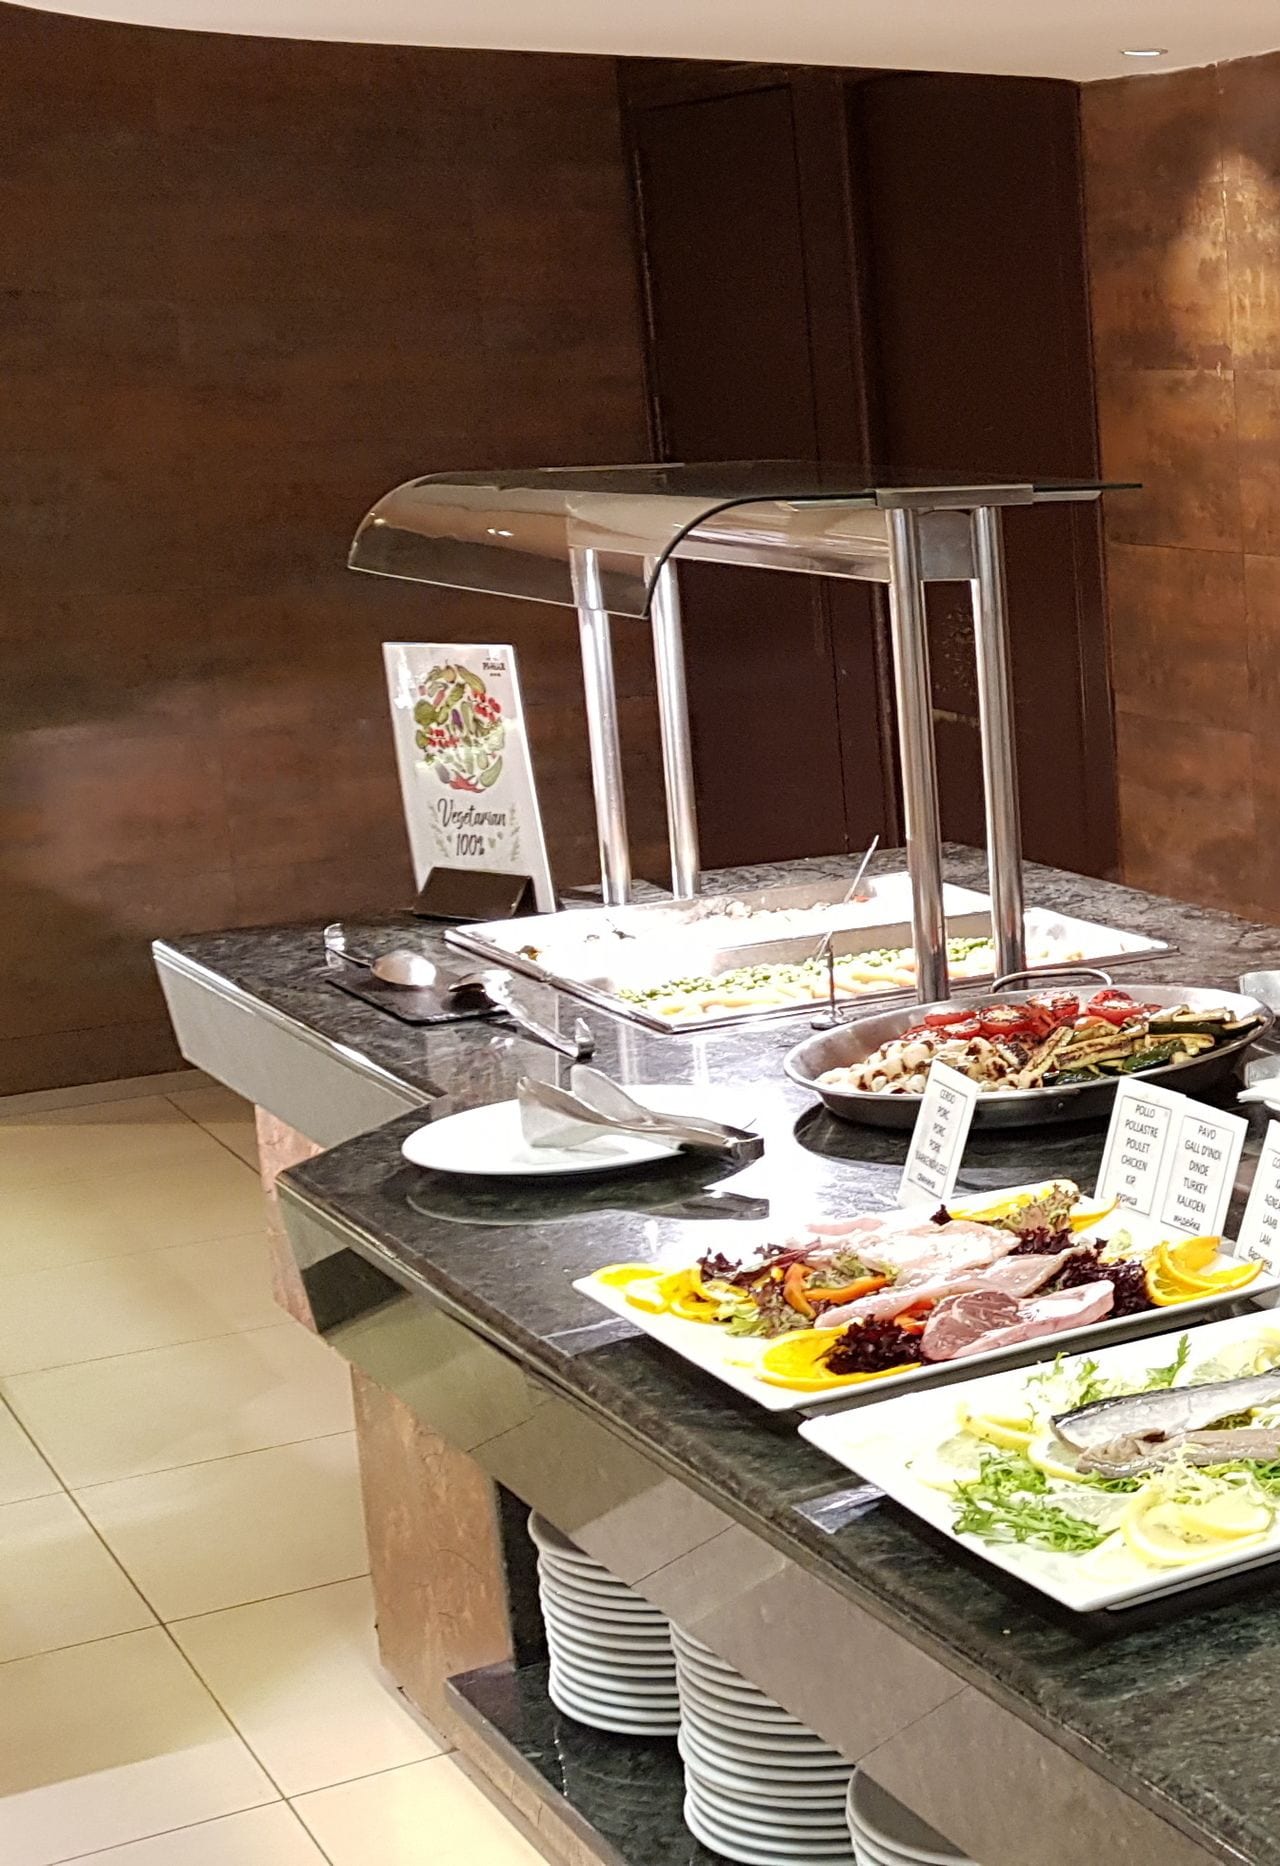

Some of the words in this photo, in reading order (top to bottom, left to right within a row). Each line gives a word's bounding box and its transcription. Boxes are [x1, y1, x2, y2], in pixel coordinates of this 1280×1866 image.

[437, 798, 506, 830] Vegetarian
[455, 833, 486, 856] 100%
[1135, 1104, 1156, 1119] POLLO
[1125, 1119, 1159, 1139] POLLASTRE
[1198, 1125, 1217, 1140] PAVO
[1126, 1137, 1151, 1154] POULET
[1184, 1139, 1201, 1156] GALL
[1121, 1154, 1148, 1172] CHICKEN
[1189, 1160, 1210, 1177] DINDE
[1183, 1176, 1208, 1195] TURKEY
[1262, 1214, 1278, 1230] LAMB
